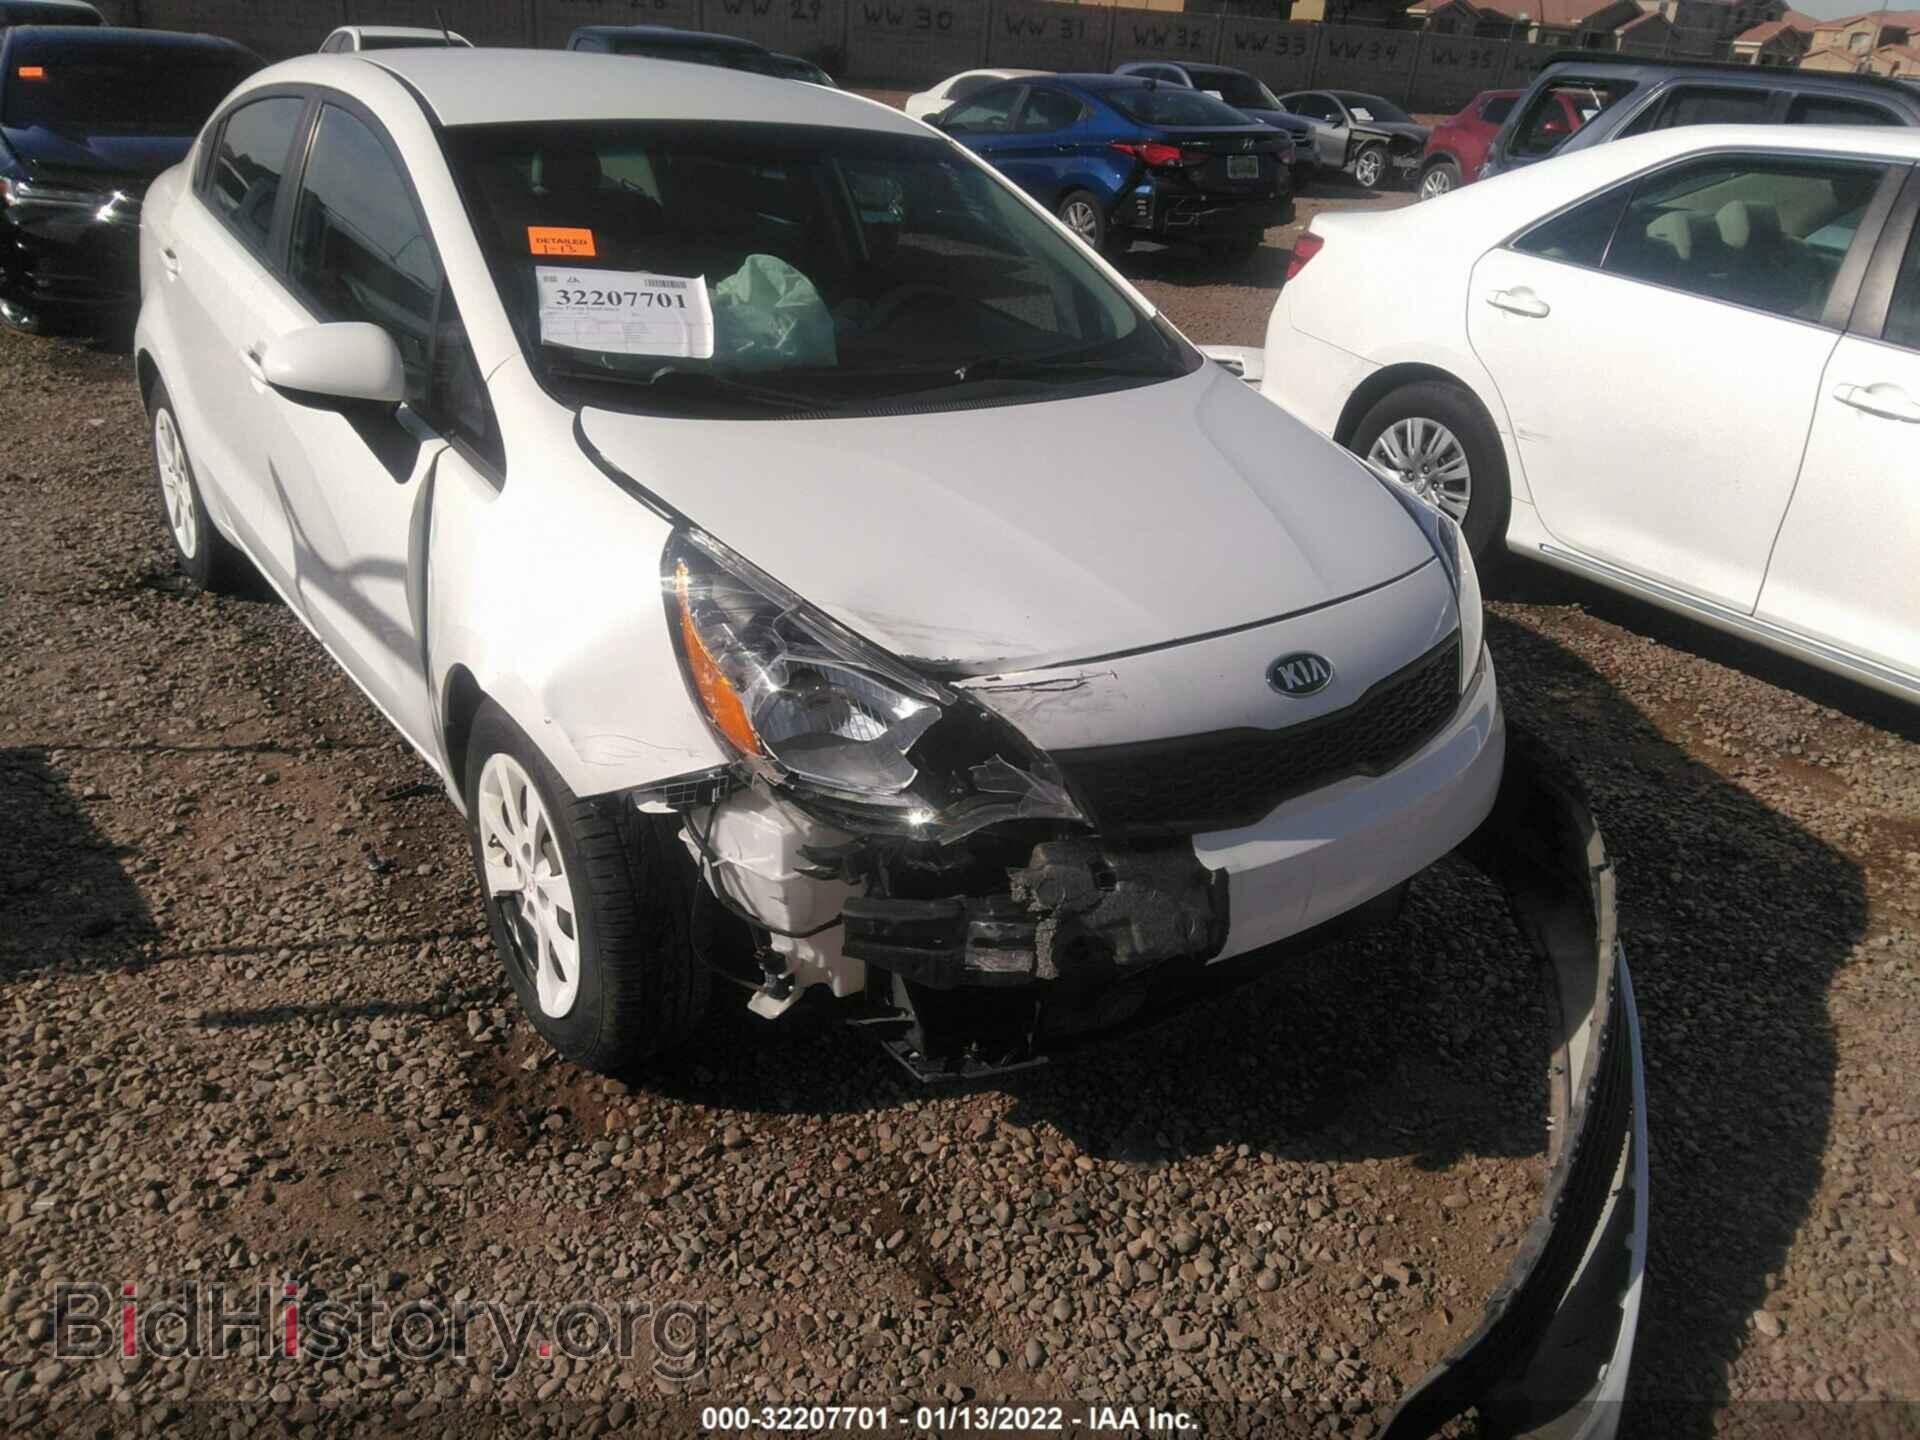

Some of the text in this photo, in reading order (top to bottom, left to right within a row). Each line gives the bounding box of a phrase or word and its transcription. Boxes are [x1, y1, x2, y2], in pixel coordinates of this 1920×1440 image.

[863, 3, 953, 31] WW 30
[1003, 13, 1085, 40] WW 31
[1131, 24, 1203, 49] WW 32
[1272, 33, 1306, 56] 33
[556, 289, 687, 309] 32207701
[1277, 657, 1328, 690] KIA
